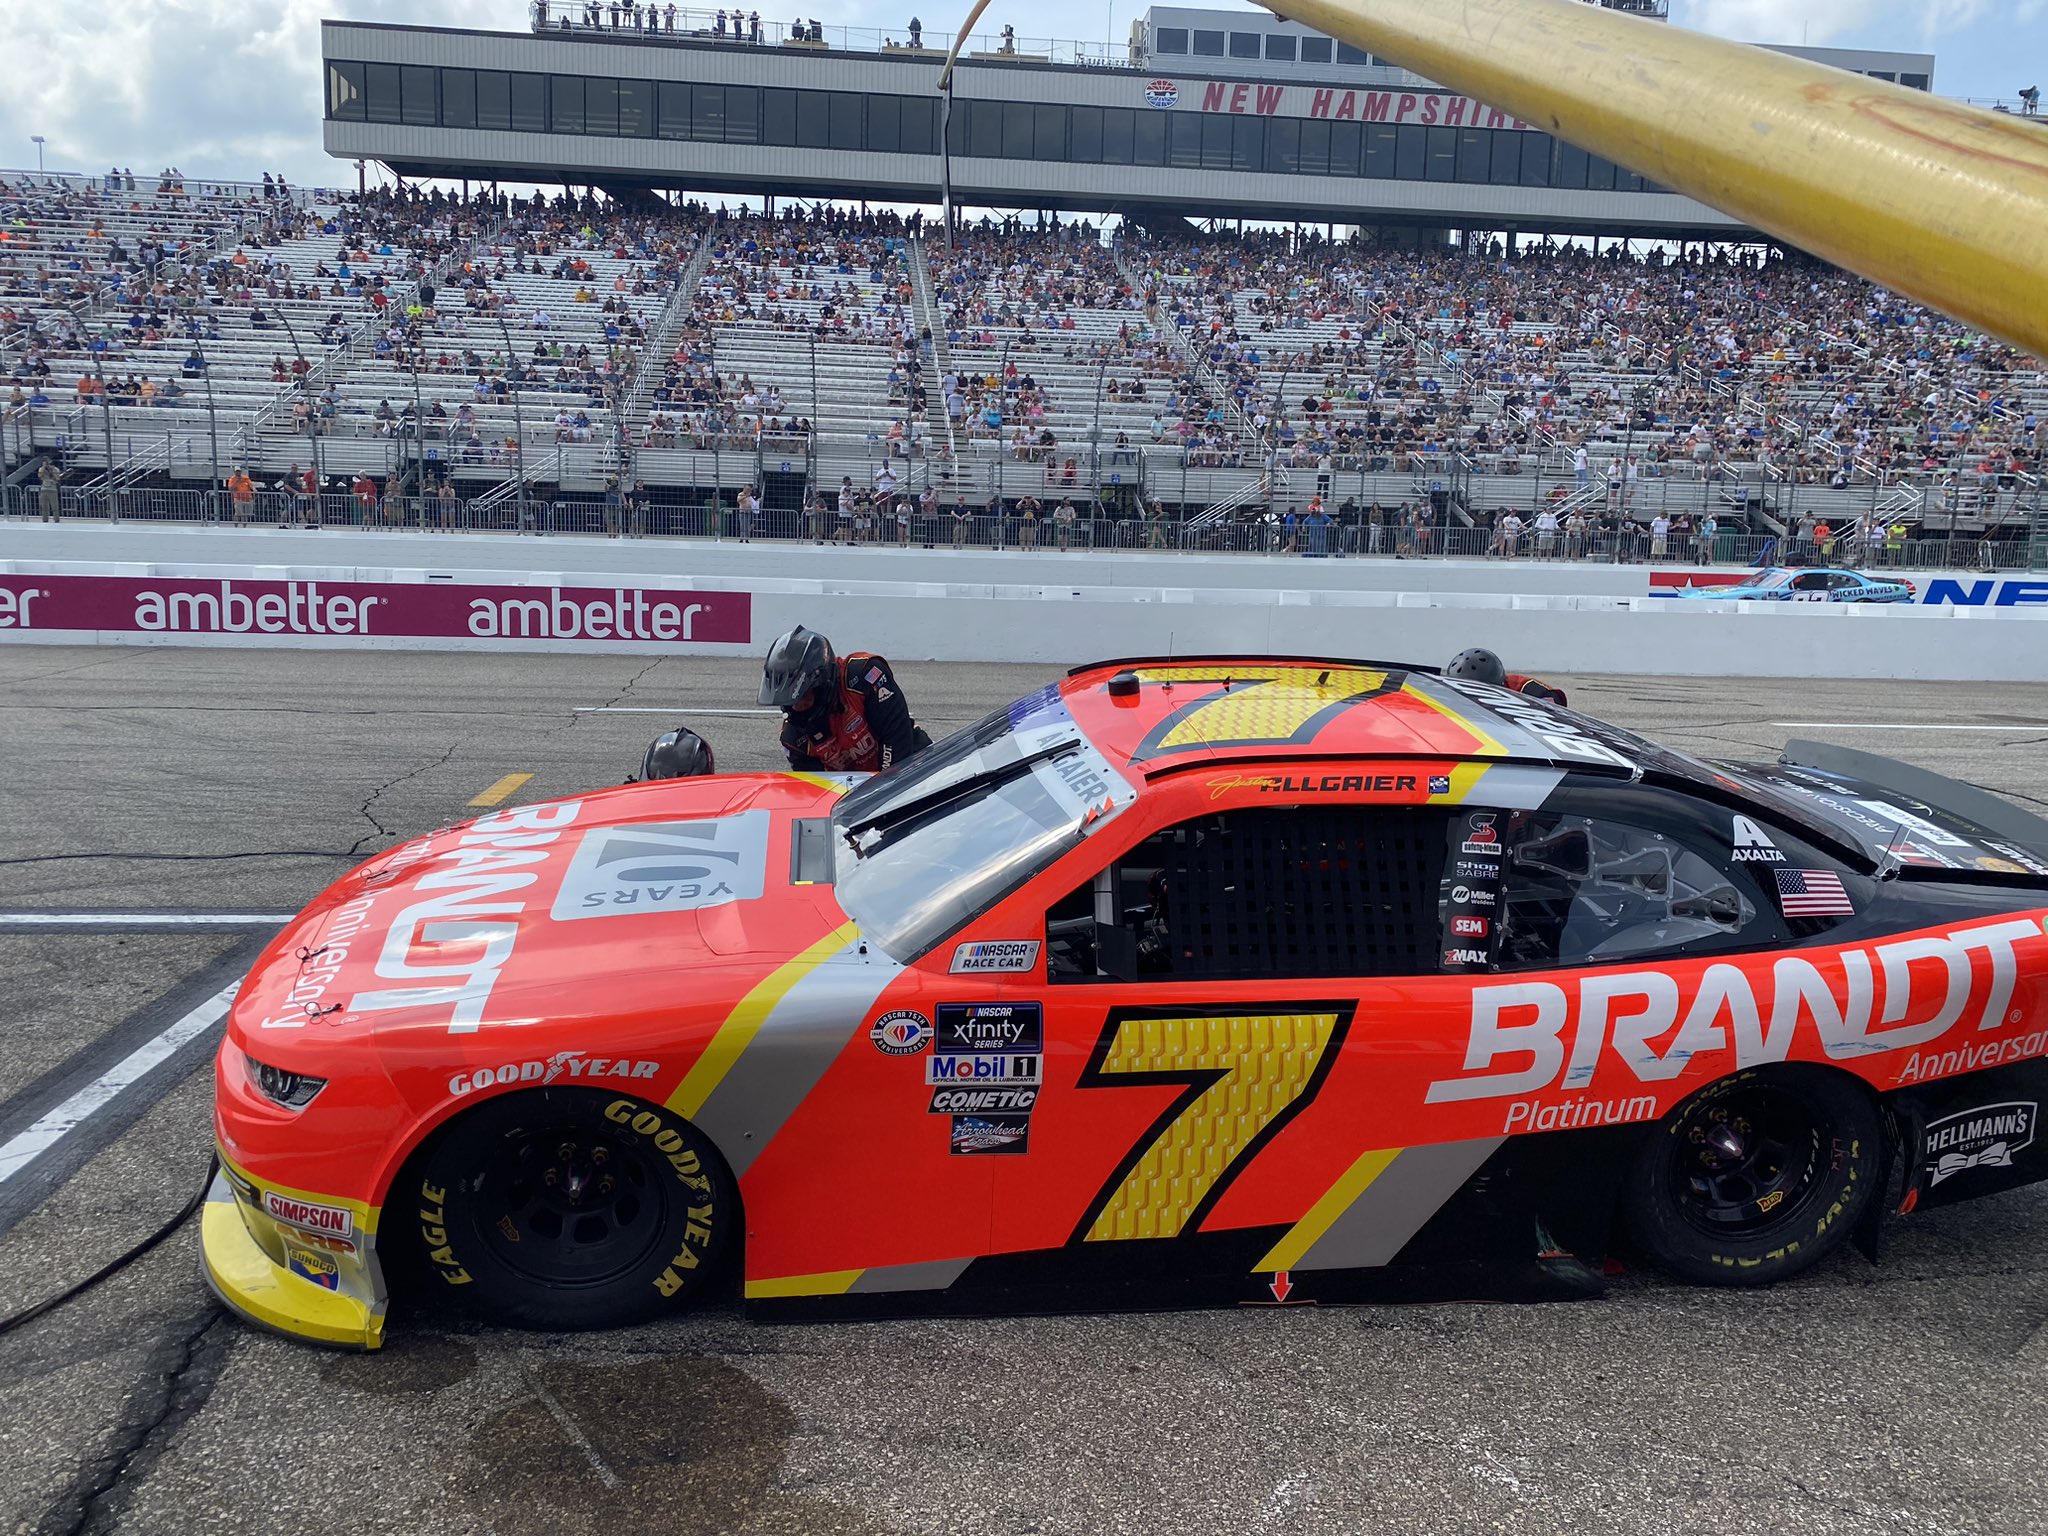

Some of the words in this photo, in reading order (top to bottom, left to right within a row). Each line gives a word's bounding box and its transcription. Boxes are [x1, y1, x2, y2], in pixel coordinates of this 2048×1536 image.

[1202, 82, 1284, 115] NEW
[1832, 588, 1864, 599] WICKED
[1866, 586, 1893, 595] WAVES
[134, 580, 378, 633] ambetter
[467, 587, 702, 640] ambetter
[881, 744, 893, 770] ANDT
[1260, 774, 1417, 793] ALLGAIER
[1731, 849, 1787, 861] AXALTA
[1456, 861, 1499, 872] Shop
[1456, 869, 1499, 879] SABRE
[582, 881, 734, 908] YEARS
[1470, 890, 1496, 900] Miller
[1455, 919, 1483, 934] SEM
[979, 944, 1028, 956] NASCAR
[962, 958, 995, 969] RACE
[998, 957, 1024, 968] CAR
[877, 1010, 907, 1027] NASCAR
[907, 1010, 927, 1026] 75TH
[976, 1007, 1013, 1017] NASCAR
[1424, 918, 2043, 1104] BRANDT
[953, 1018, 1026, 1044] xfinity
[877, 1037, 928, 1054] ANNIVERSARY
[973, 1039, 1005, 1049] SERIES
[932, 1056, 1006, 1078] Mobil
[1898, 1030, 2048, 1084] Anniversar
[932, 1090, 1037, 1109] COMETIC
[1070, 1000, 1358, 1247] 7
[1503, 1095, 1658, 1134] Platinum
[952, 1121, 1028, 1137] Arrowhead
[1926, 1108, 2029, 1155] HELLMANN'S
[269, 1196, 345, 1231] SIMPSON
[420, 1179, 474, 1285] EAGLE
[290, 1250, 336, 1274] SUNOCO
